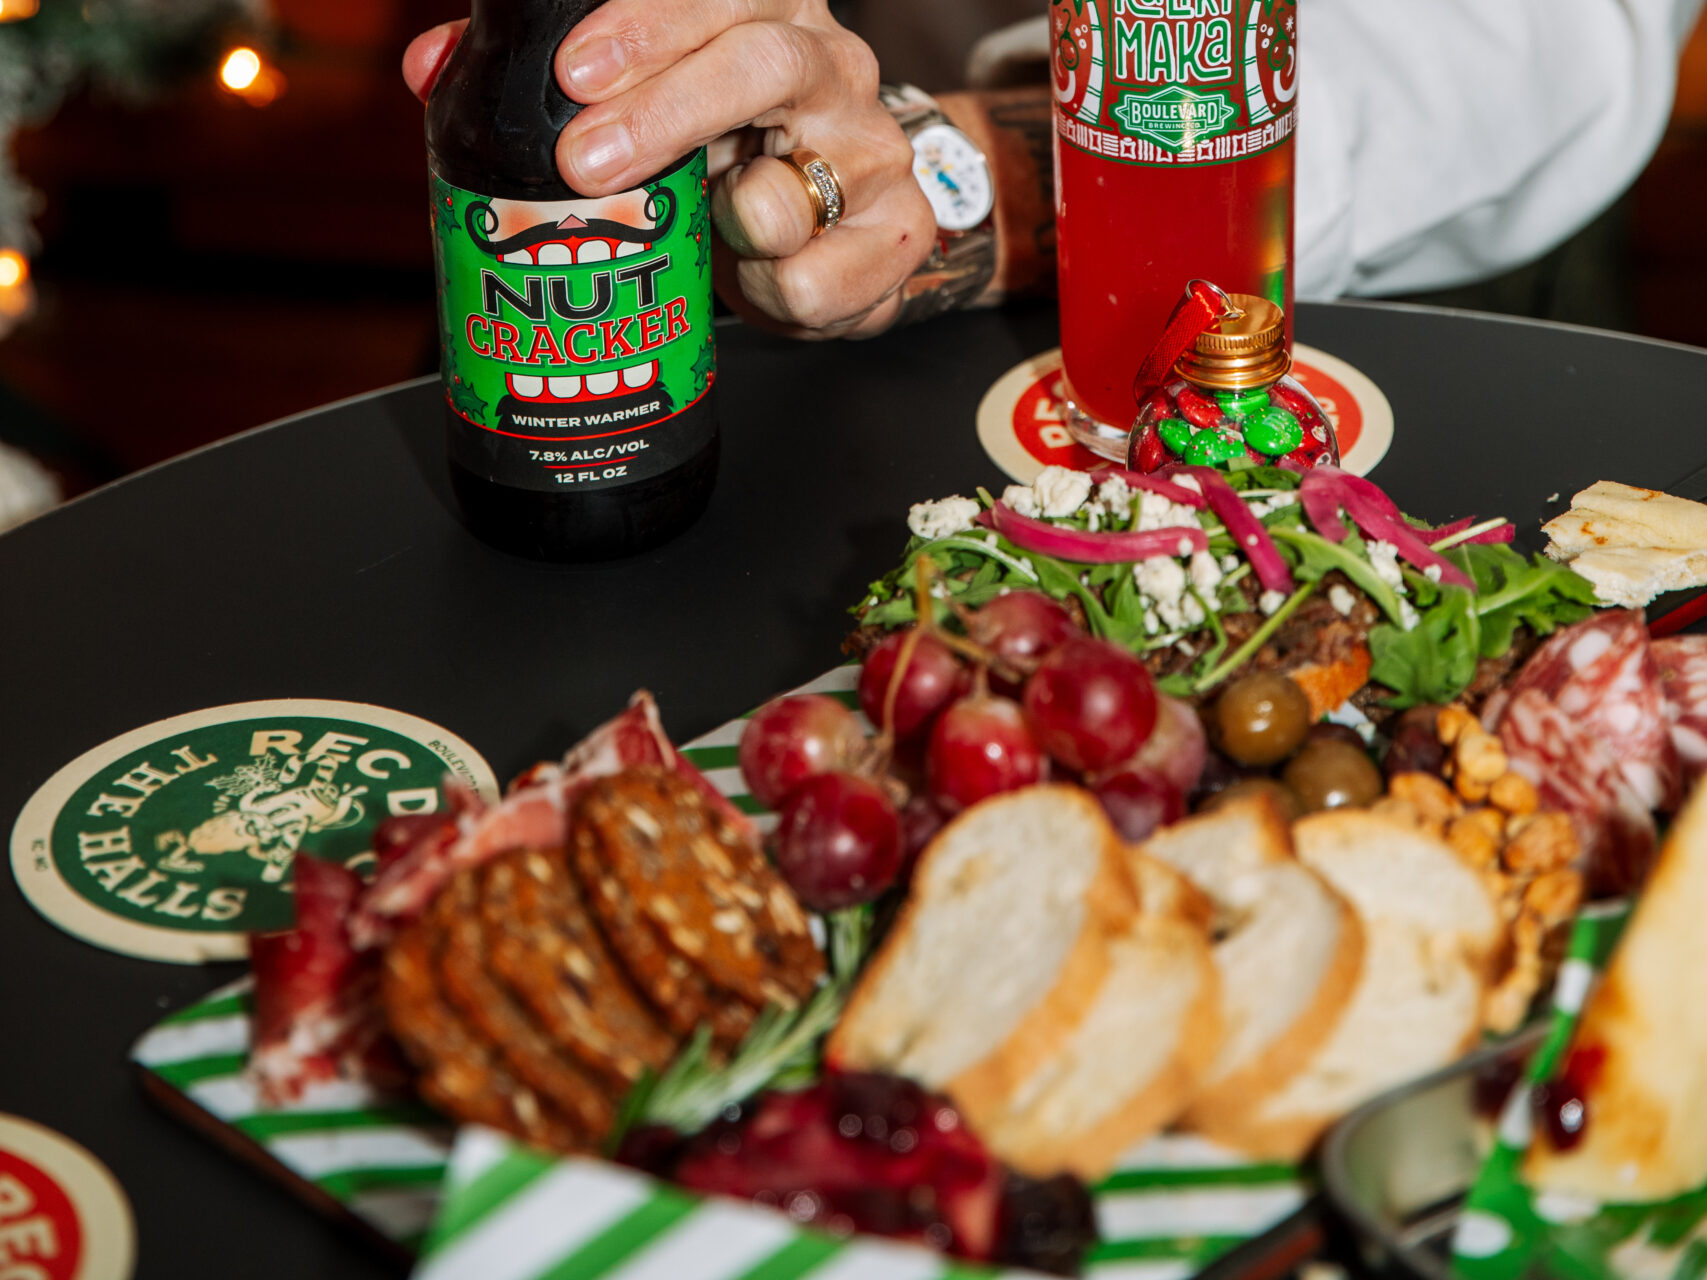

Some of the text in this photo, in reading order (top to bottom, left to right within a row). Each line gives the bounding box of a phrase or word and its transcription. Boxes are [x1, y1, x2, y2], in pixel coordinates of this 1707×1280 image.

[1131, 101, 1218, 124] BOULEVARD
[480, 253, 671, 322] NUT
[465, 296, 692, 366] CRACKER
[511, 400, 661, 428] WINTER WARMER
[529, 439, 650, 462] 7.8% ALC/VOL
[555, 465, 628, 484] 12 FL OZ
[249, 729, 411, 780] REC
[78, 745, 247, 922] THE HALLS
